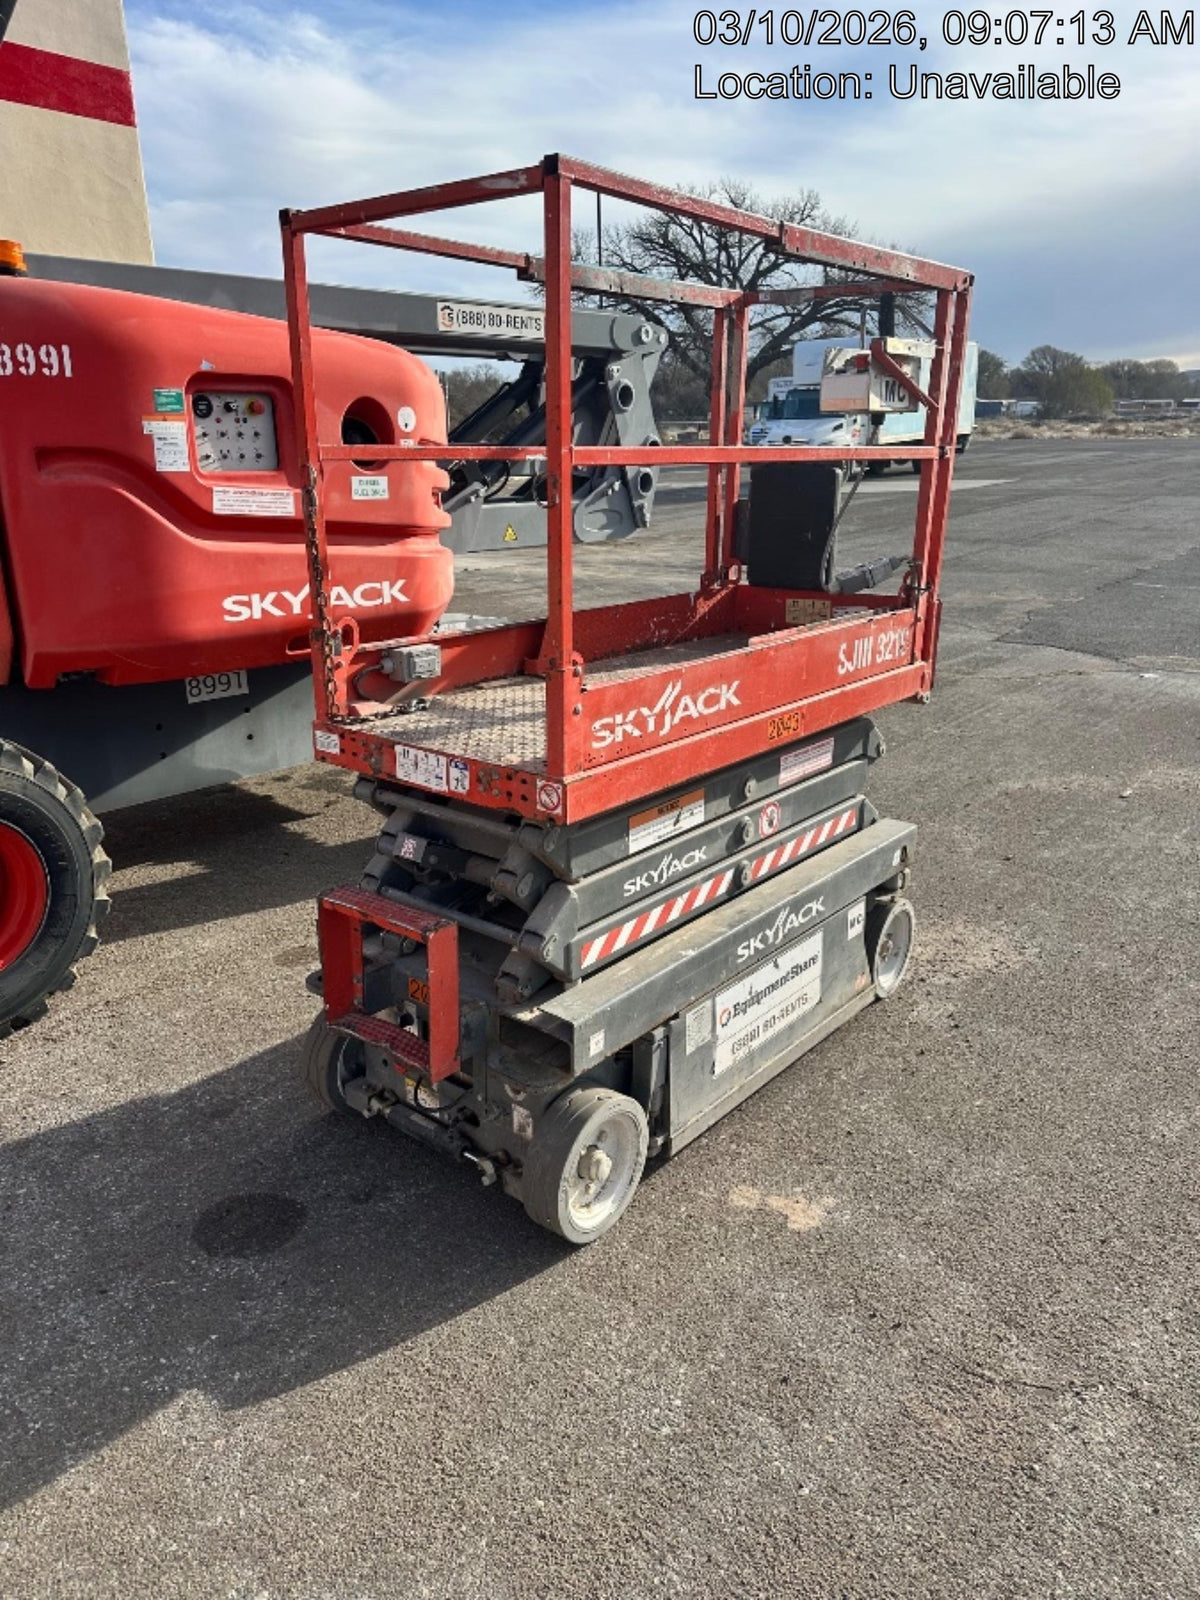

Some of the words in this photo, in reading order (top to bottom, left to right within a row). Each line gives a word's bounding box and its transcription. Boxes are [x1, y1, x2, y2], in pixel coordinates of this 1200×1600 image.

[0, 343, 73, 377] 8991
[222, 579, 411, 622] SKYACK
[188, 671, 242, 697] 8991
[591, 679, 742, 749] SKYJACK
[623, 846, 707, 897] SKYJACK
[736, 896, 826, 963] SKYJACK
[732, 954, 819, 1019] EquipmentShare
